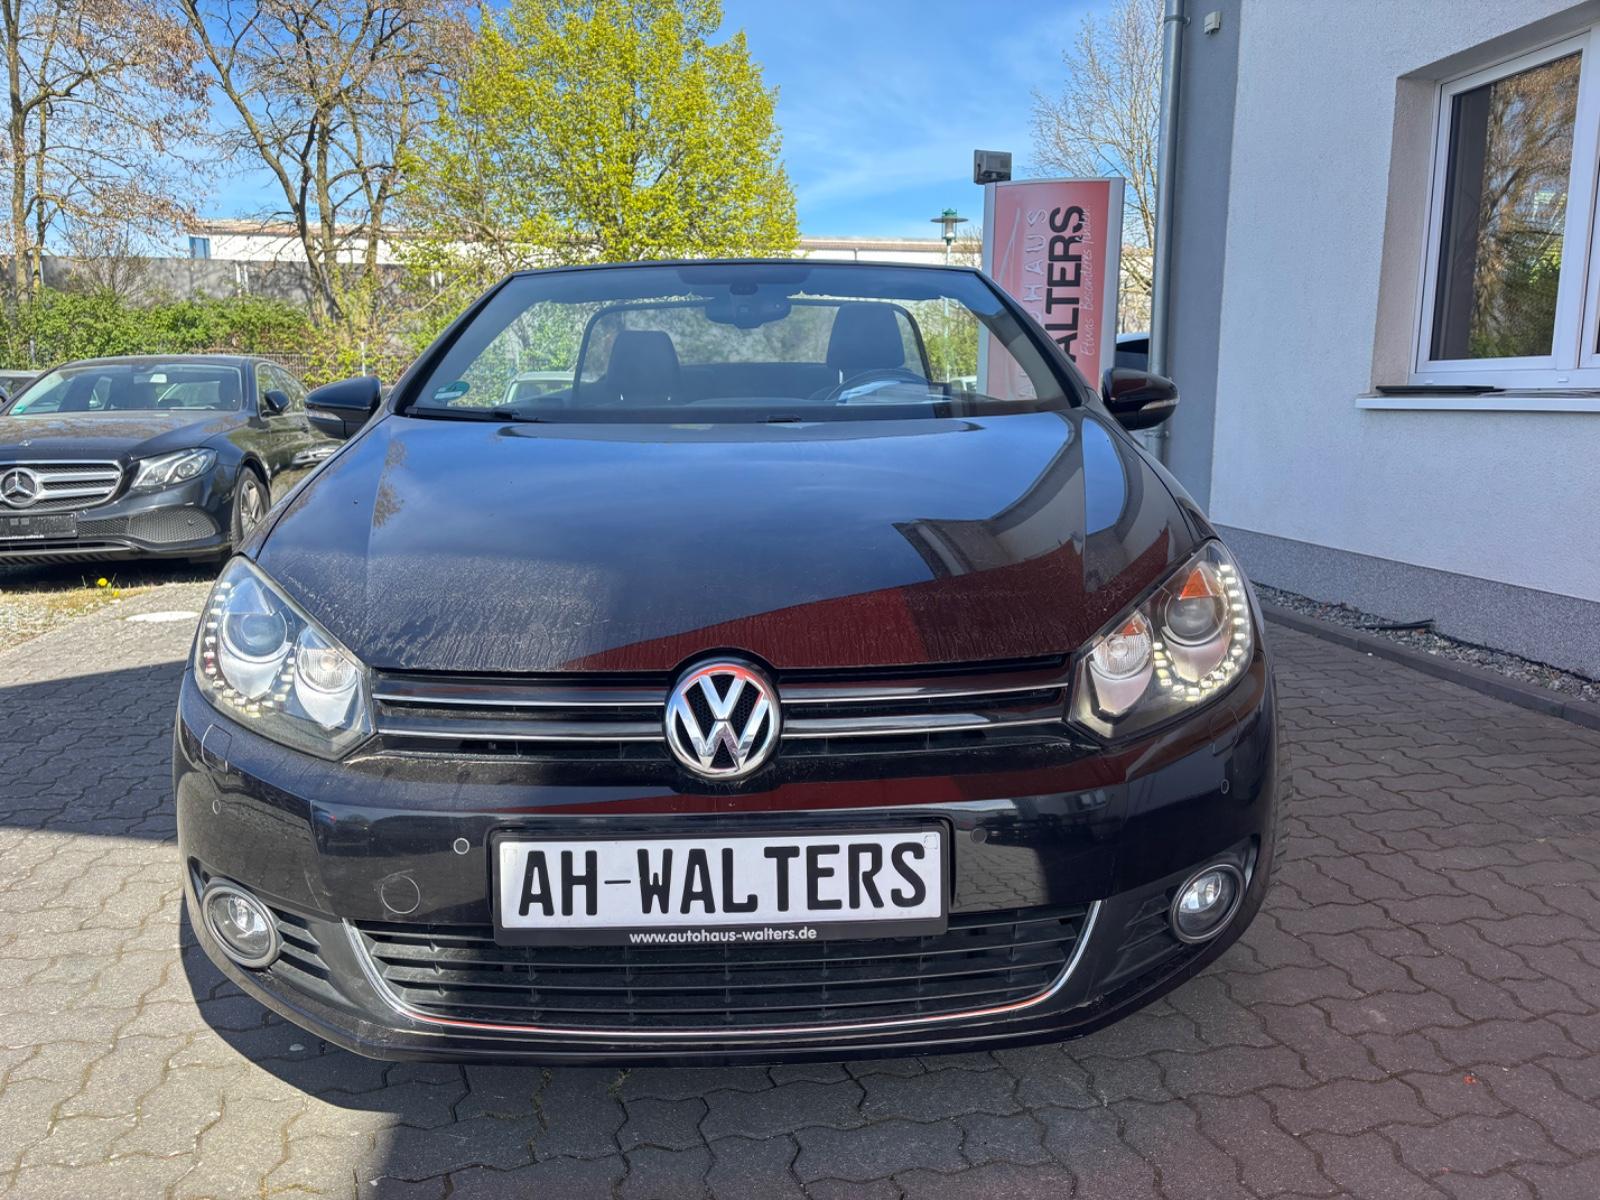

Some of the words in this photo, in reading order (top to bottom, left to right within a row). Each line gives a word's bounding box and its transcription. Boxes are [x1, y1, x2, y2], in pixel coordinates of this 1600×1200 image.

[1044, 205, 1084, 363] ALTERS
[671, 667, 774, 774] VW
[518, 842, 927, 917] AH-WALTERS
[629, 926, 818, 944] www.autohaus-walters.de
